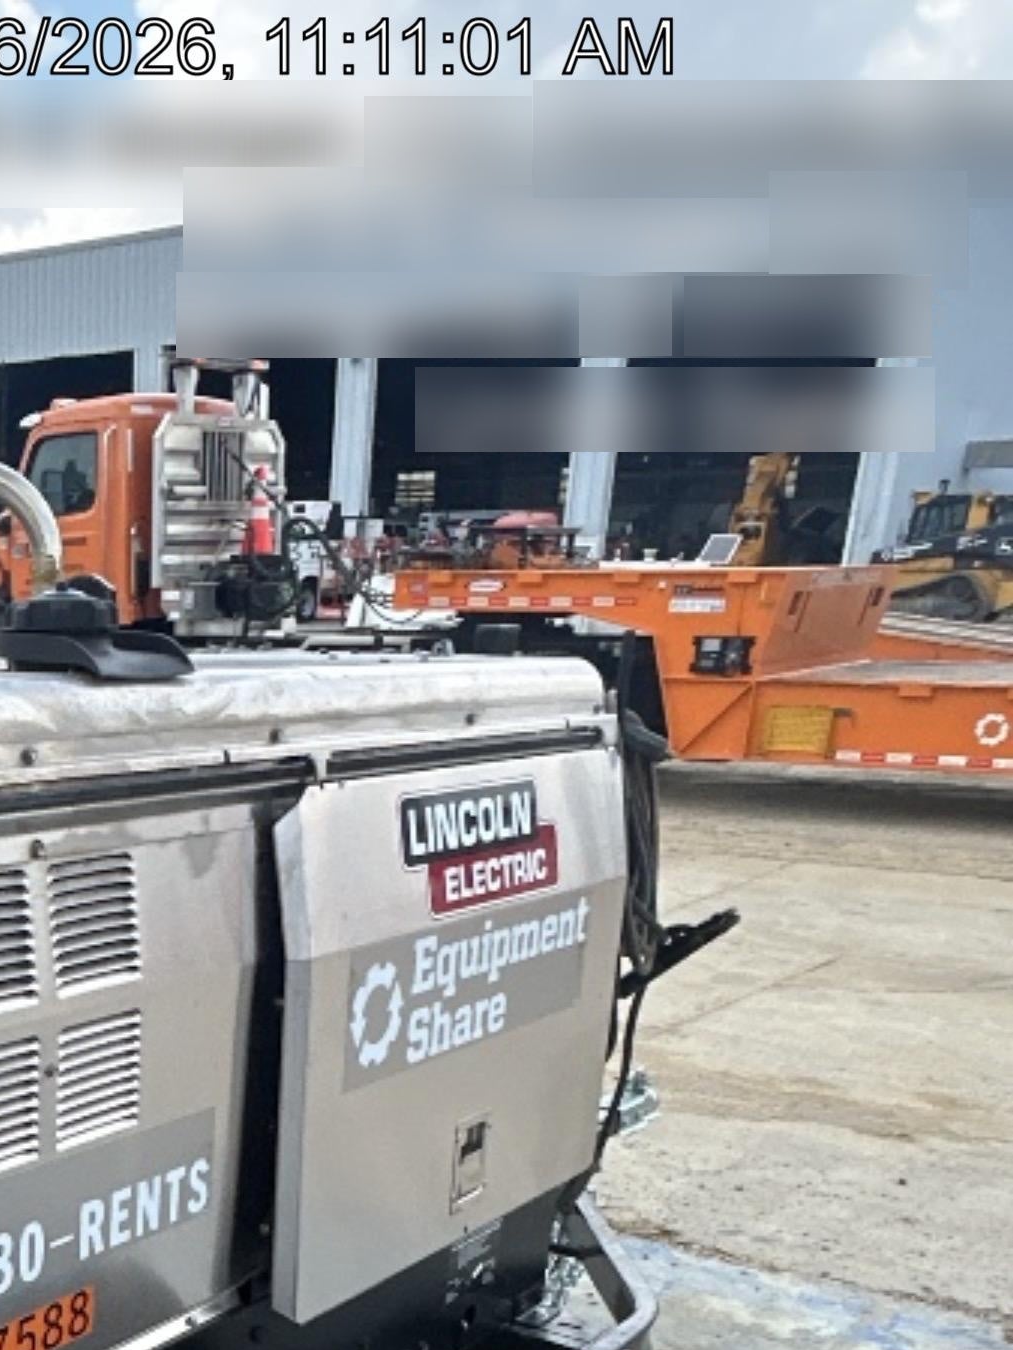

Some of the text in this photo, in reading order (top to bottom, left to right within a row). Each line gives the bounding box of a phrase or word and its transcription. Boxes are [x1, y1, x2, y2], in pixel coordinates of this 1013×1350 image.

[407, 791, 532, 856] LINCOLN
[443, 848, 547, 903] ELECTRIC
[410, 897, 590, 997] Equipment
[406, 992, 507, 1064] Share
